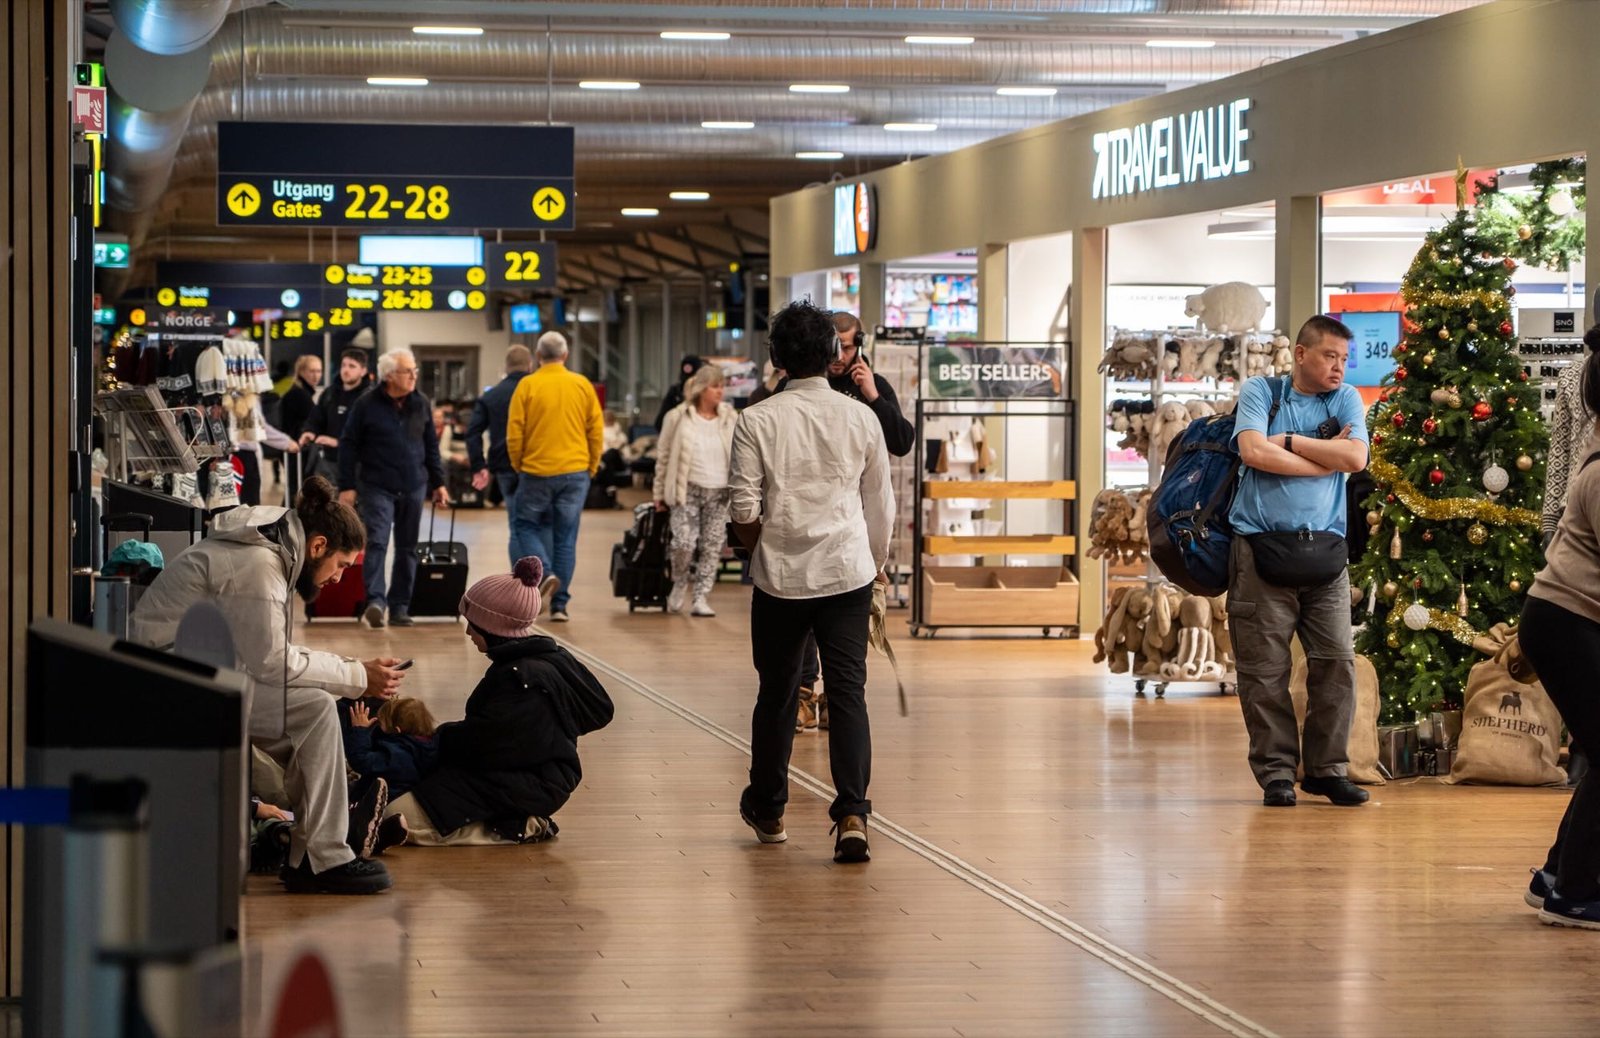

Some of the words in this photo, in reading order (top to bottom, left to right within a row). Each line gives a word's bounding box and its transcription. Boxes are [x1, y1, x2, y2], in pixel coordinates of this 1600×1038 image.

[1108, 116, 1180, 196] TRAVEL
[1179, 98, 1249, 183] VALUE
[273, 180, 334, 202] Utgang
[272, 200, 322, 218] Gates
[345, 184, 450, 220] 22-28
[382, 266, 433, 285] 23-25
[505, 251, 541, 281] 22
[382, 290, 433, 309] 26-28
[165, 316, 212, 327] NORGE
[939, 363, 1052, 381] BESTSELLERS
[1471, 716, 1546, 737] SHEPHERD
